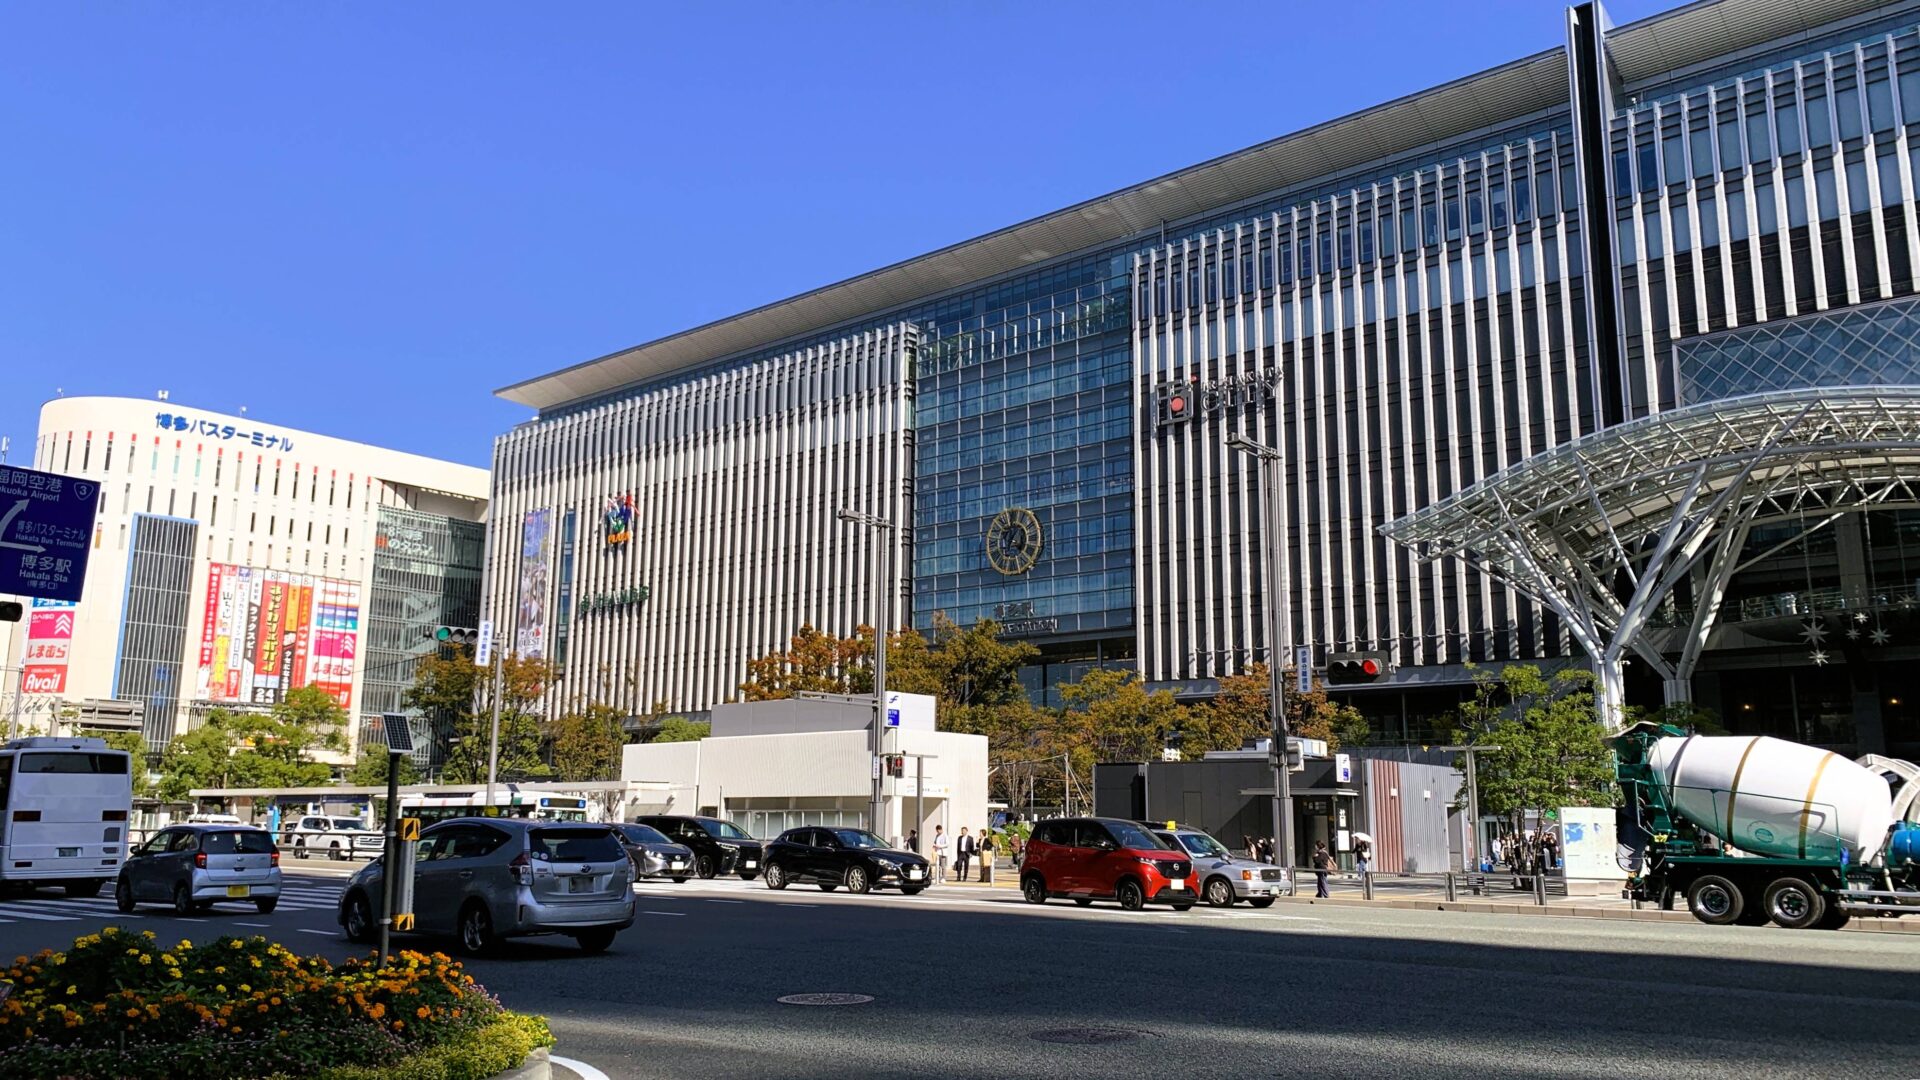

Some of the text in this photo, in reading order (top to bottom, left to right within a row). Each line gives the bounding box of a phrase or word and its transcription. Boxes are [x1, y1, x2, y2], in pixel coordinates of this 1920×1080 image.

[155, 412, 294, 452] 博多バスターミナル
[0, 485, 60, 502] kuoka Airport
[79, 485, 88, 496] 3
[16, 520, 86, 540] 博多バスターミナル
[15, 533, 39, 543] Hakata
[56, 538, 84, 549] Terminal
[21, 554, 72, 574] 博多駅
[19, 569, 68, 583] Hakata Sta
[28, 644, 67, 659] しまむら
[25, 673, 61, 691] Avail
